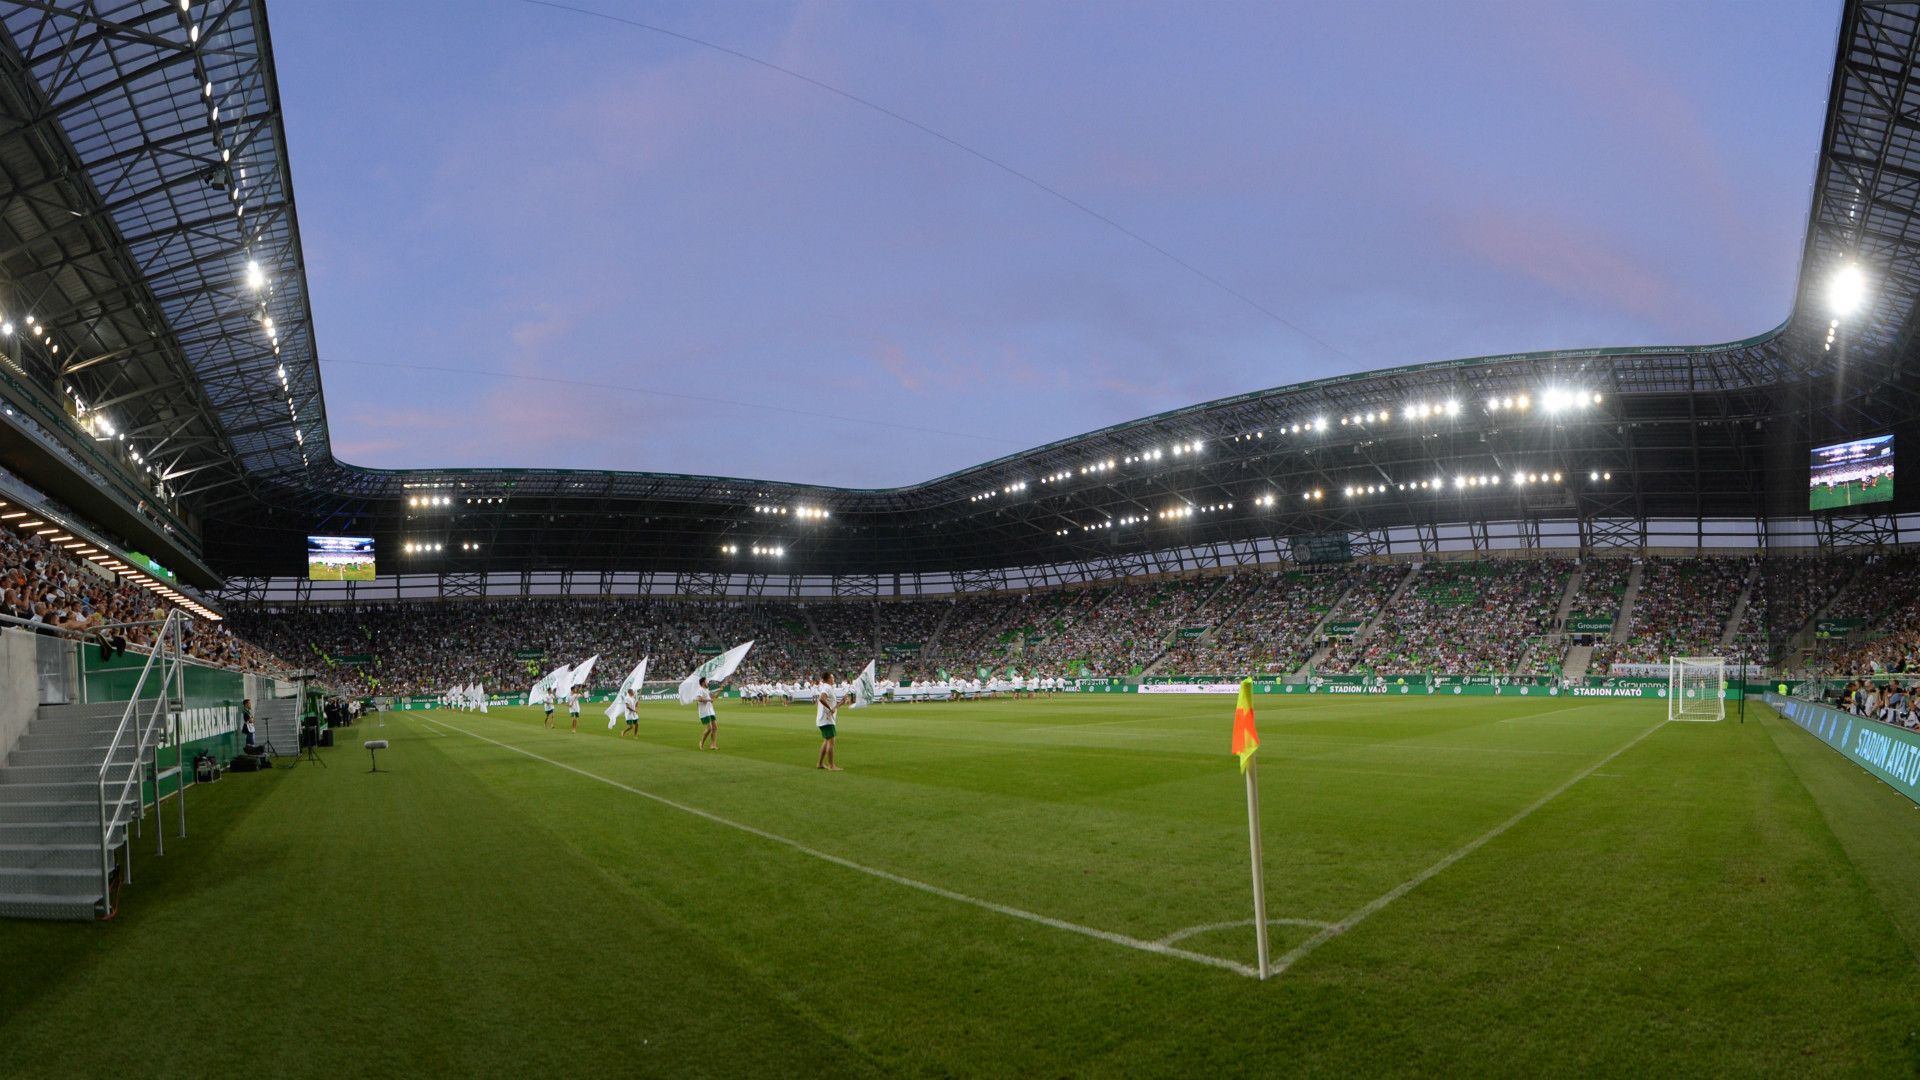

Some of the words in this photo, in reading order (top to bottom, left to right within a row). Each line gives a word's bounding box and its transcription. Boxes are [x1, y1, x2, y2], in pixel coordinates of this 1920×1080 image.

[1329, 685, 1362, 693] STADION
[1573, 687, 1612, 696] STADION
[1613, 686, 1642, 697] AVATÓ
[1854, 728, 1891, 769] STADION
